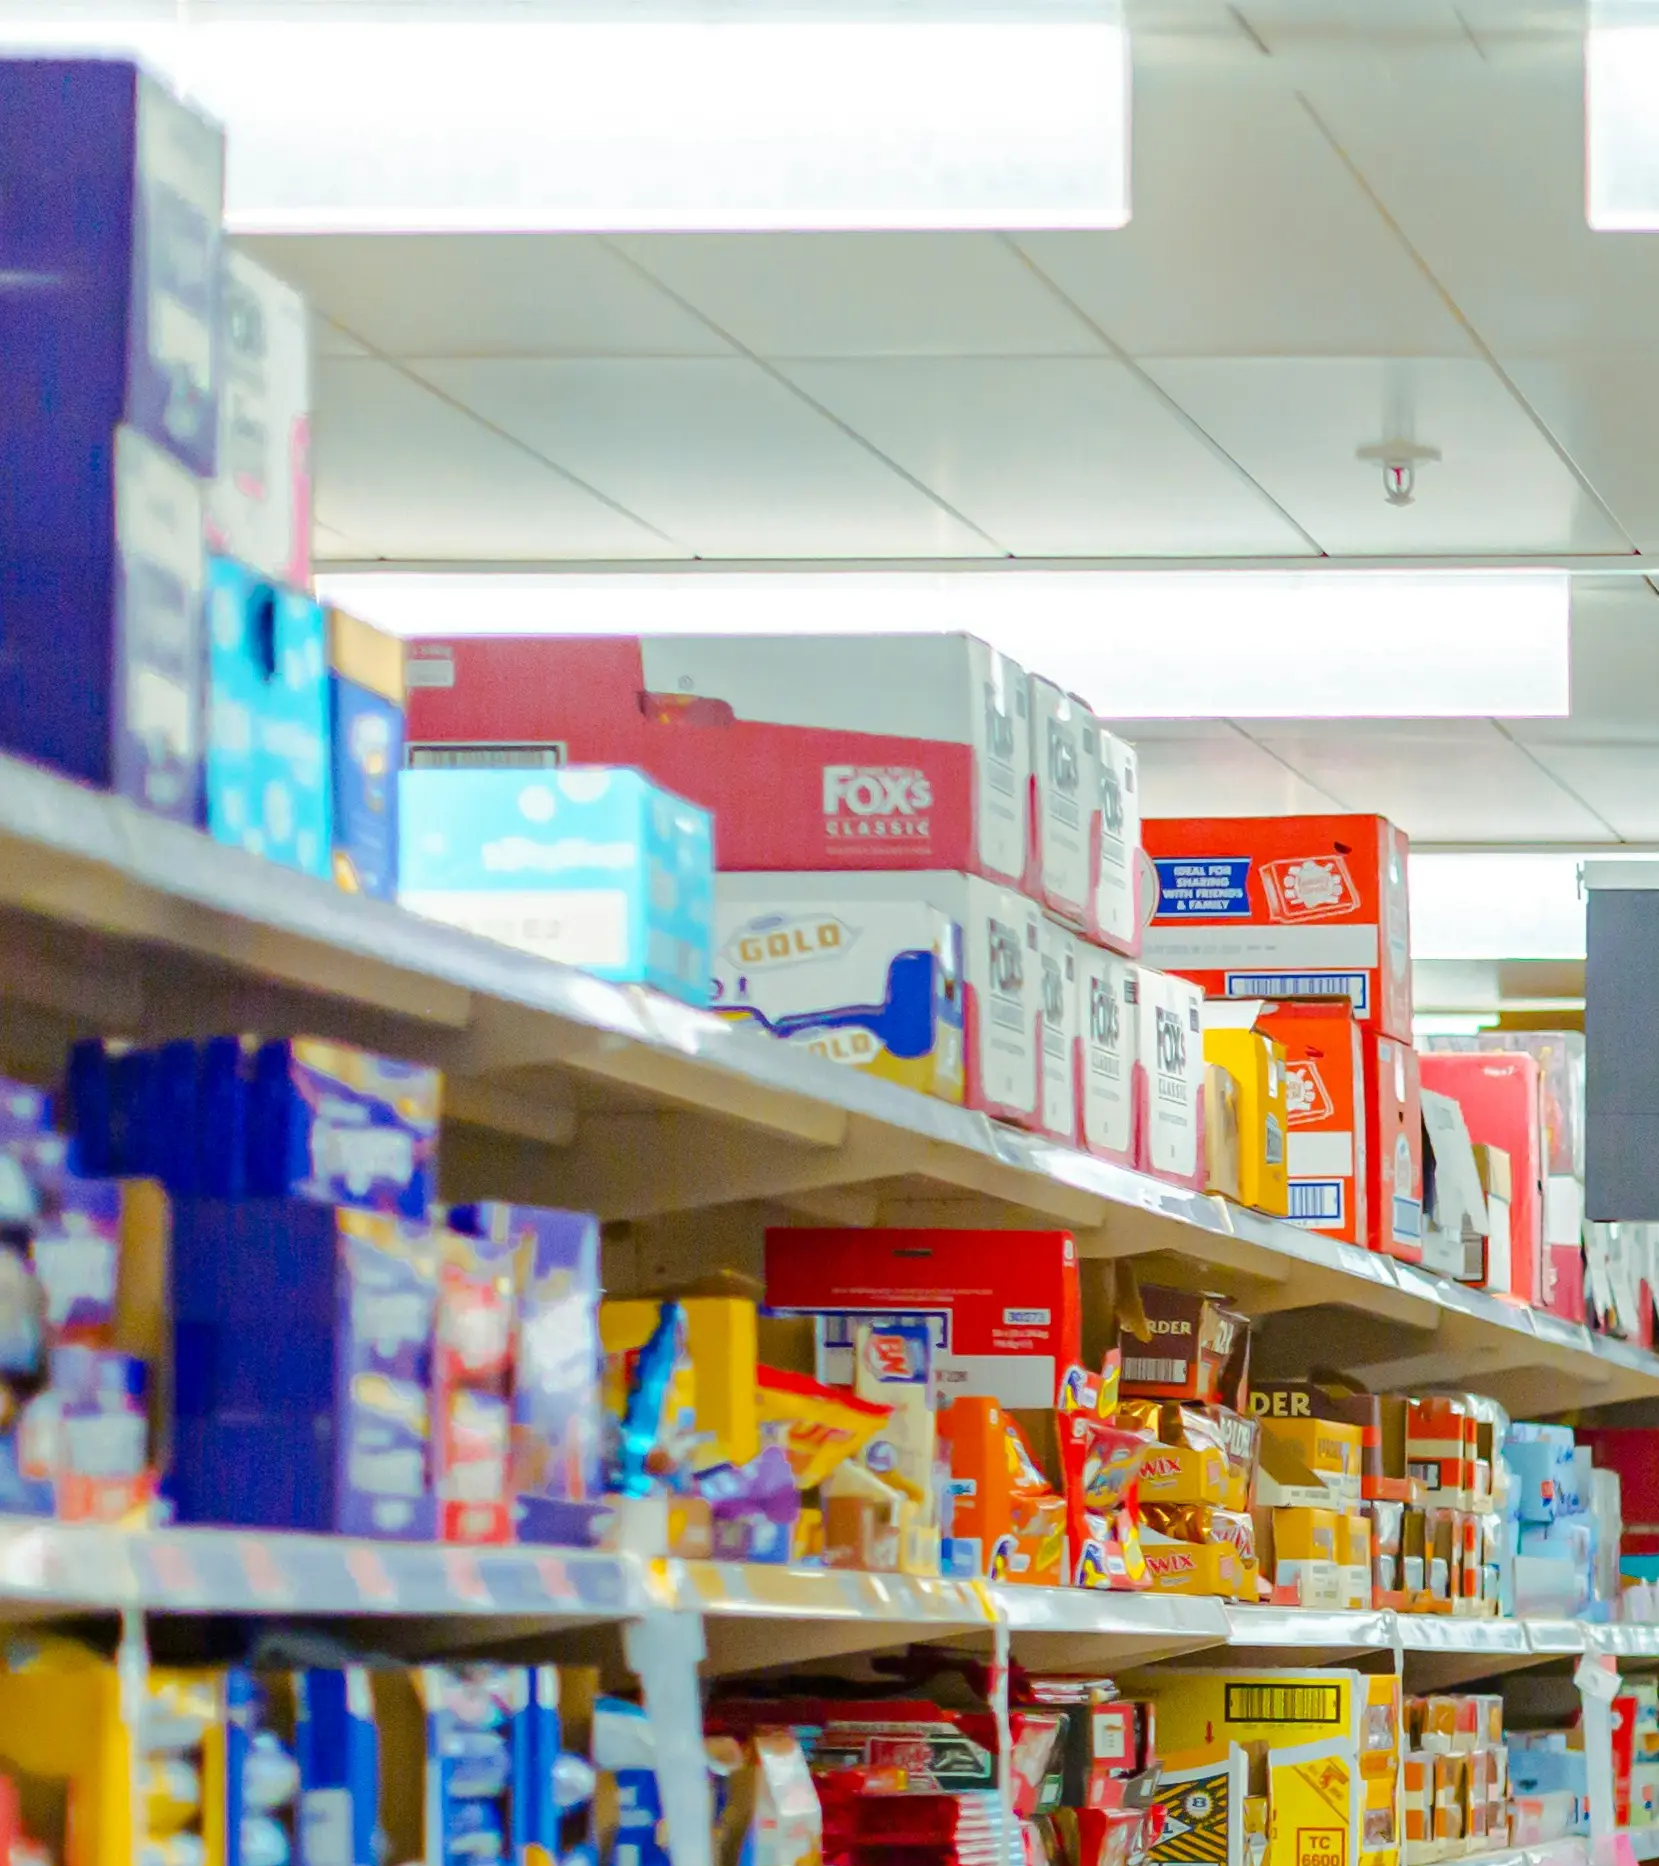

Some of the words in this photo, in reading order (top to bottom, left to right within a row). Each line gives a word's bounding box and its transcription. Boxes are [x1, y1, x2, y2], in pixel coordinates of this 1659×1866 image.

[826, 821, 930, 837] CLASSIC
[740, 923, 840, 962] GOLD
[1139, 1456, 1182, 1480] WIX
[1309, 1836, 1331, 1850] TC
